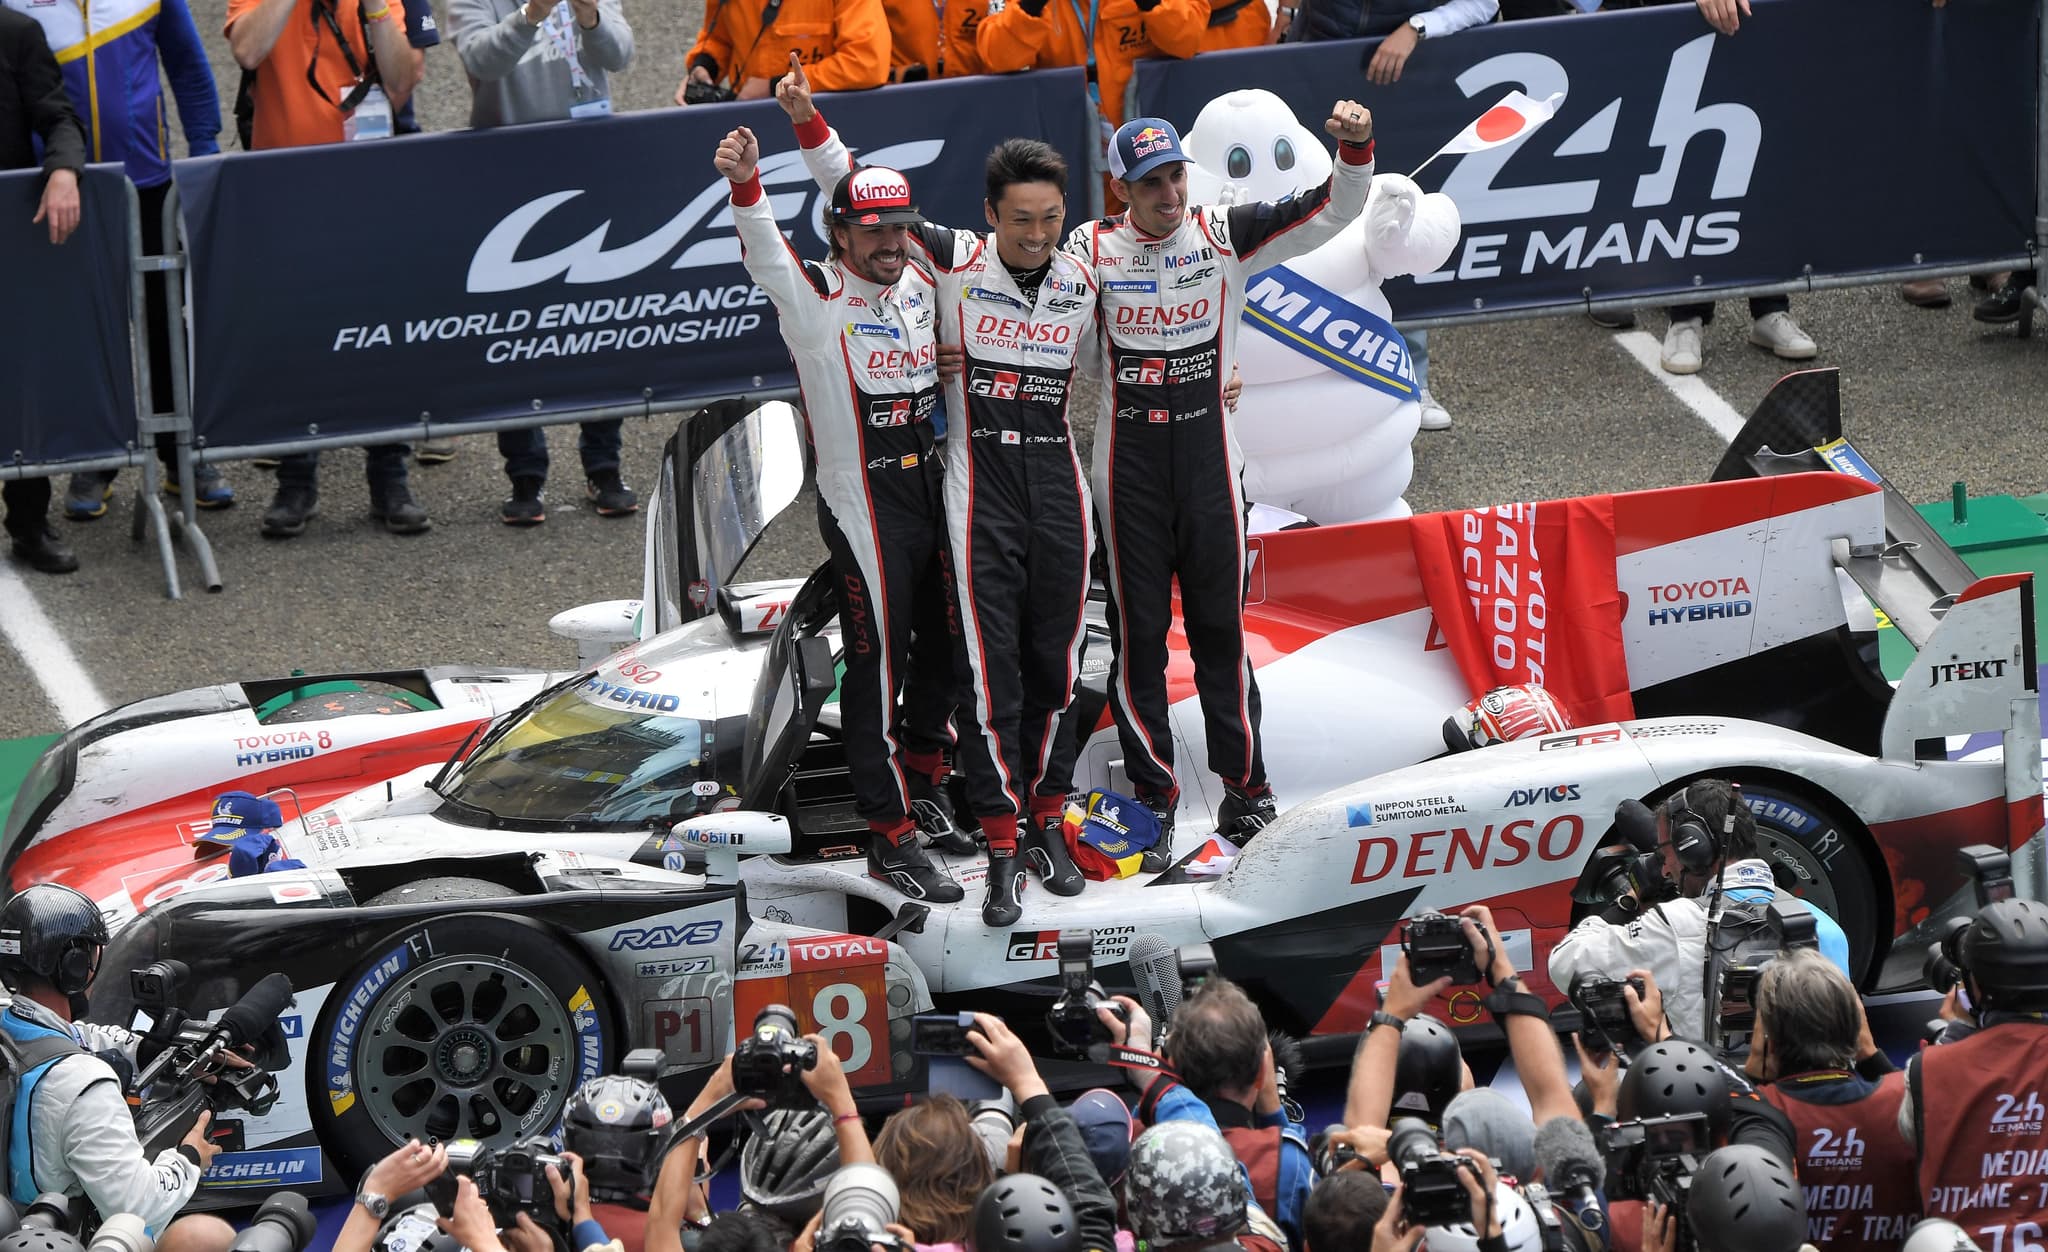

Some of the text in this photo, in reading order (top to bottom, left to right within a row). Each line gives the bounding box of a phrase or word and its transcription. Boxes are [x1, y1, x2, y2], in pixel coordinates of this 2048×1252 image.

[1438, 32, 1762, 225] 24h
[1135, 138, 1173, 159] Red Bull
[854, 183, 907, 201] kimoa
[1521, 211, 1740, 274] MANS
[1164, 248, 1213, 269] Mobil 1
[1044, 275, 1087, 296] Mobil 1
[1177, 266, 1216, 285] WEC
[333, 284, 768, 352] FIA WORLD ENDURANCE
[1116, 298, 1209, 326] DENSO
[976, 314, 1071, 344] DENSO
[1116, 319, 1211, 337] TOYOTA HYBRID
[1250, 277, 1416, 384] MICHEL
[485, 314, 761, 364] CHAMPIONSHIP
[975, 335, 1019, 350] TOYOTA
[867, 341, 936, 369] DENSO
[1169, 348, 1217, 367] TOYOTA
[868, 370, 905, 380] TOYOTA
[1025, 374, 1067, 386] TOYOTA
[1166, 369, 1212, 384] Racing
[1019, 393, 1062, 405] Racing
[1023, 384, 1064, 395] GAZOO
[1648, 577, 1751, 603] TOYOTA
[1649, 600, 1752, 626] HYBRID
[1929, 659, 2008, 688] JTEKT
[581, 678, 680, 713] HYBRID
[234, 730, 333, 750] TOYOTA 8
[236, 744, 314, 767] HYBRID
[1375, 795, 1455, 813] NIPPON STEEL &
[1376, 805, 1468, 823] SUMITOMO METAL
[687, 829, 744, 845] Mobil 1
[1350, 814, 1584, 885] DENSO
[668, 855, 682, 870] N
[608, 920, 723, 951] RAYS
[1094, 925, 1136, 936] YOTA
[1094, 936, 1129, 946] ZOO
[741, 940, 883, 964] 24h TOTAL
[1008, 942, 1058, 960] GR
[1091, 946, 1126, 957] cing
[640, 959, 710, 976] 林テレンプ
[754, 962, 784, 971] MANS
[332, 955, 400, 1068] MICHELIN
[655, 1009, 701, 1053] P1
[812, 983, 873, 1074] 8
[1120, 1051, 1160, 1068] Canon
[1992, 1091, 2046, 1124] 24h
[2007, 1121, 2042, 1132] MANS
[1808, 1127, 1866, 1157] 24h
[1807, 1157, 1863, 1167] LE MANS
[1982, 1150, 2048, 1179] MEDIA
[1800, 1184, 1874, 1211] MEDIA
